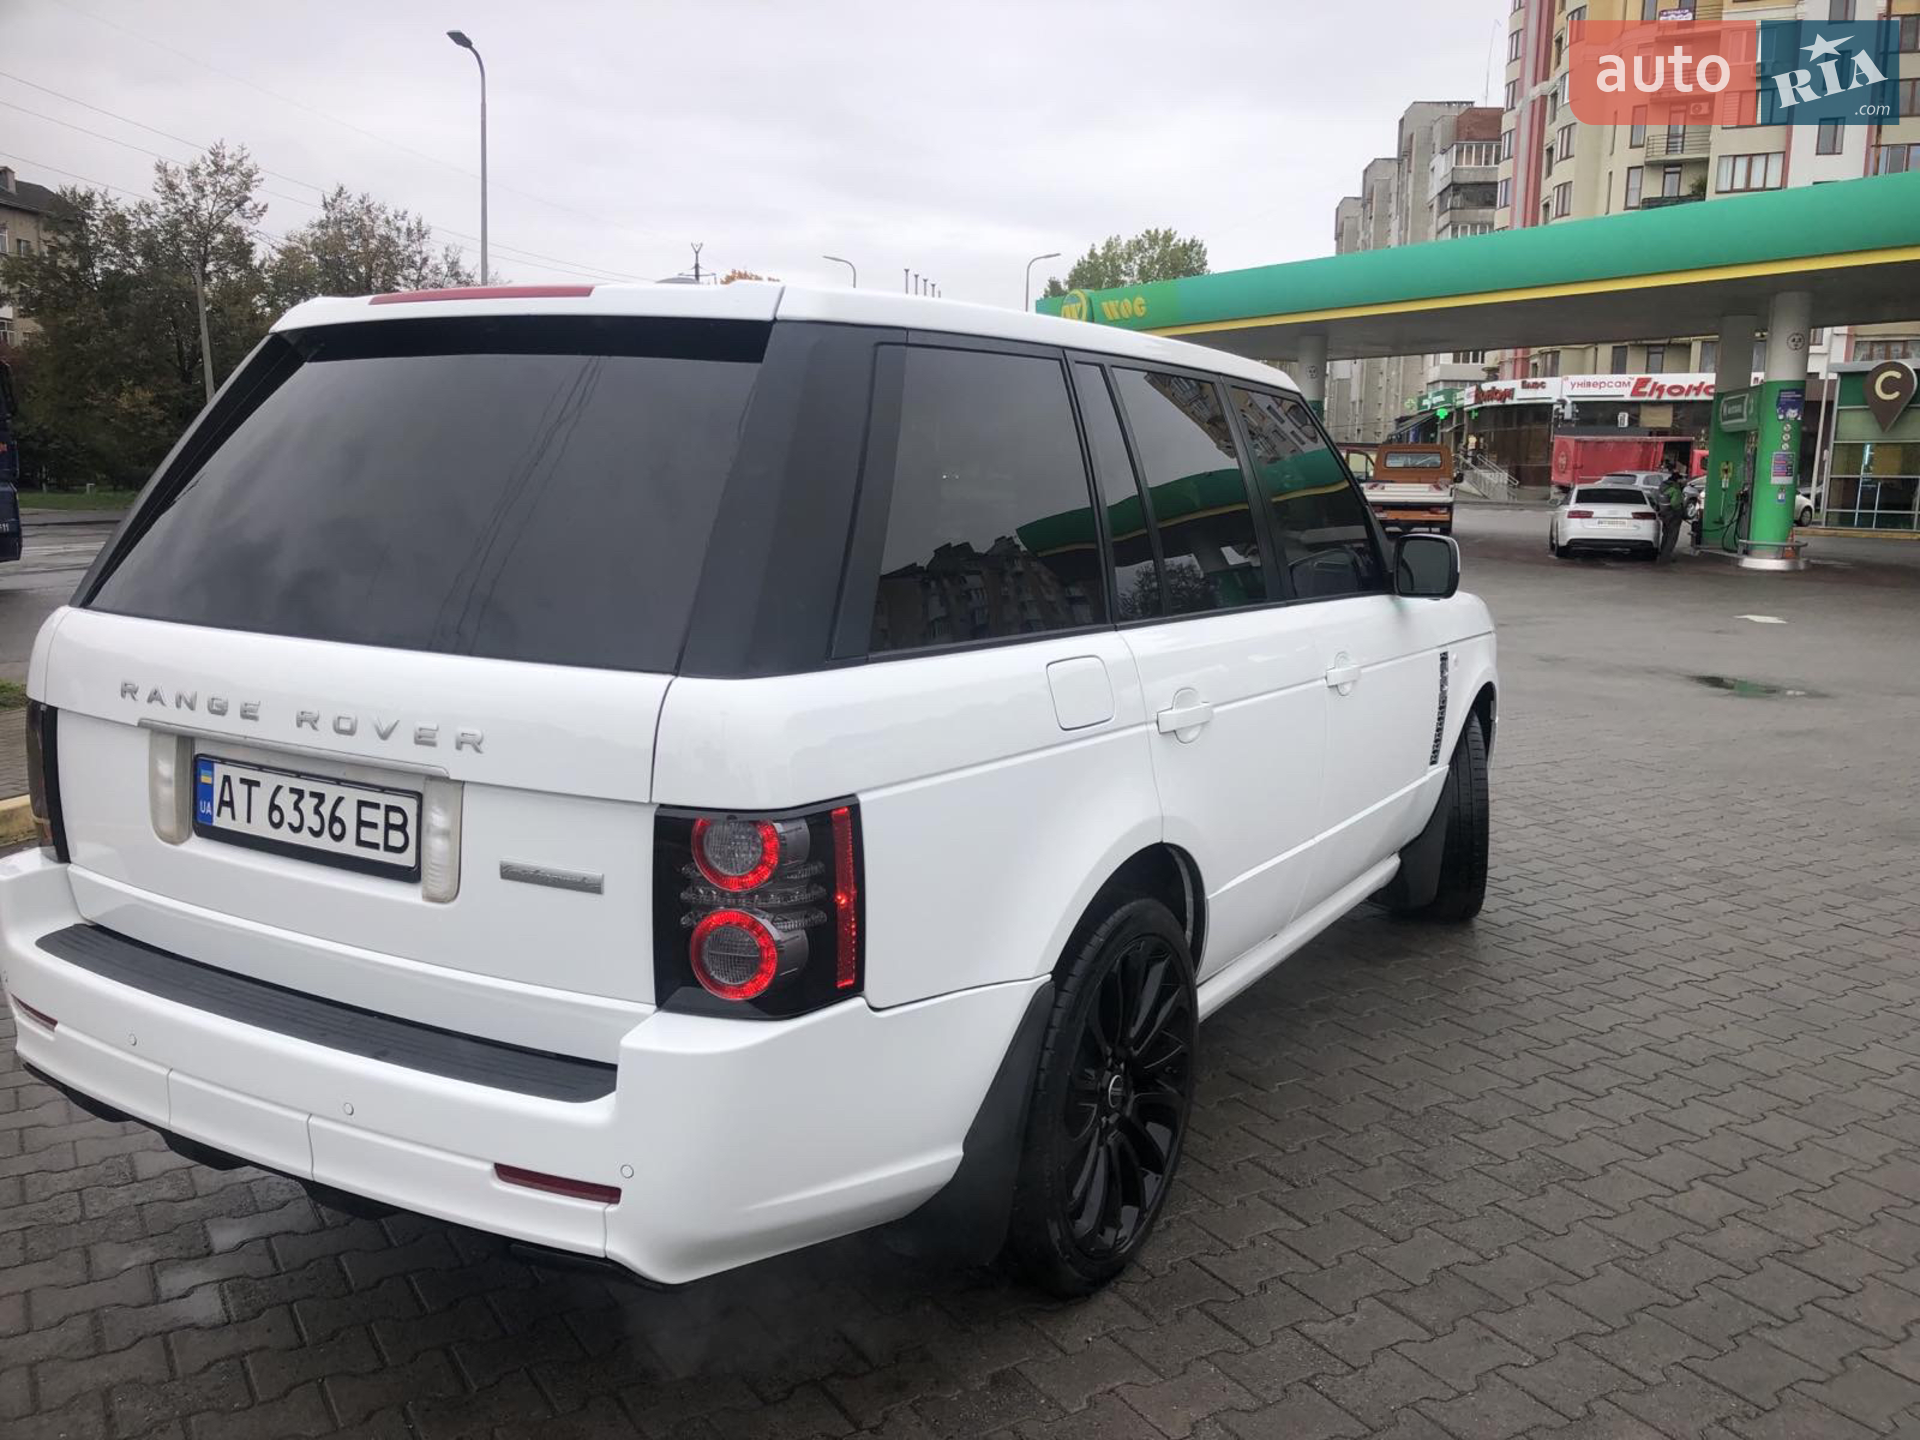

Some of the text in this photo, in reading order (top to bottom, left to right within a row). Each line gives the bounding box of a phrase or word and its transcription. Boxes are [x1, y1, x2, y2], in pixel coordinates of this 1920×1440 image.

[1101, 296, 1147, 321] WOG
[119, 680, 485, 754] RANGE ROVER
[200, 800, 212, 815] UA
[216, 774, 410, 855] AT 6336 EB
